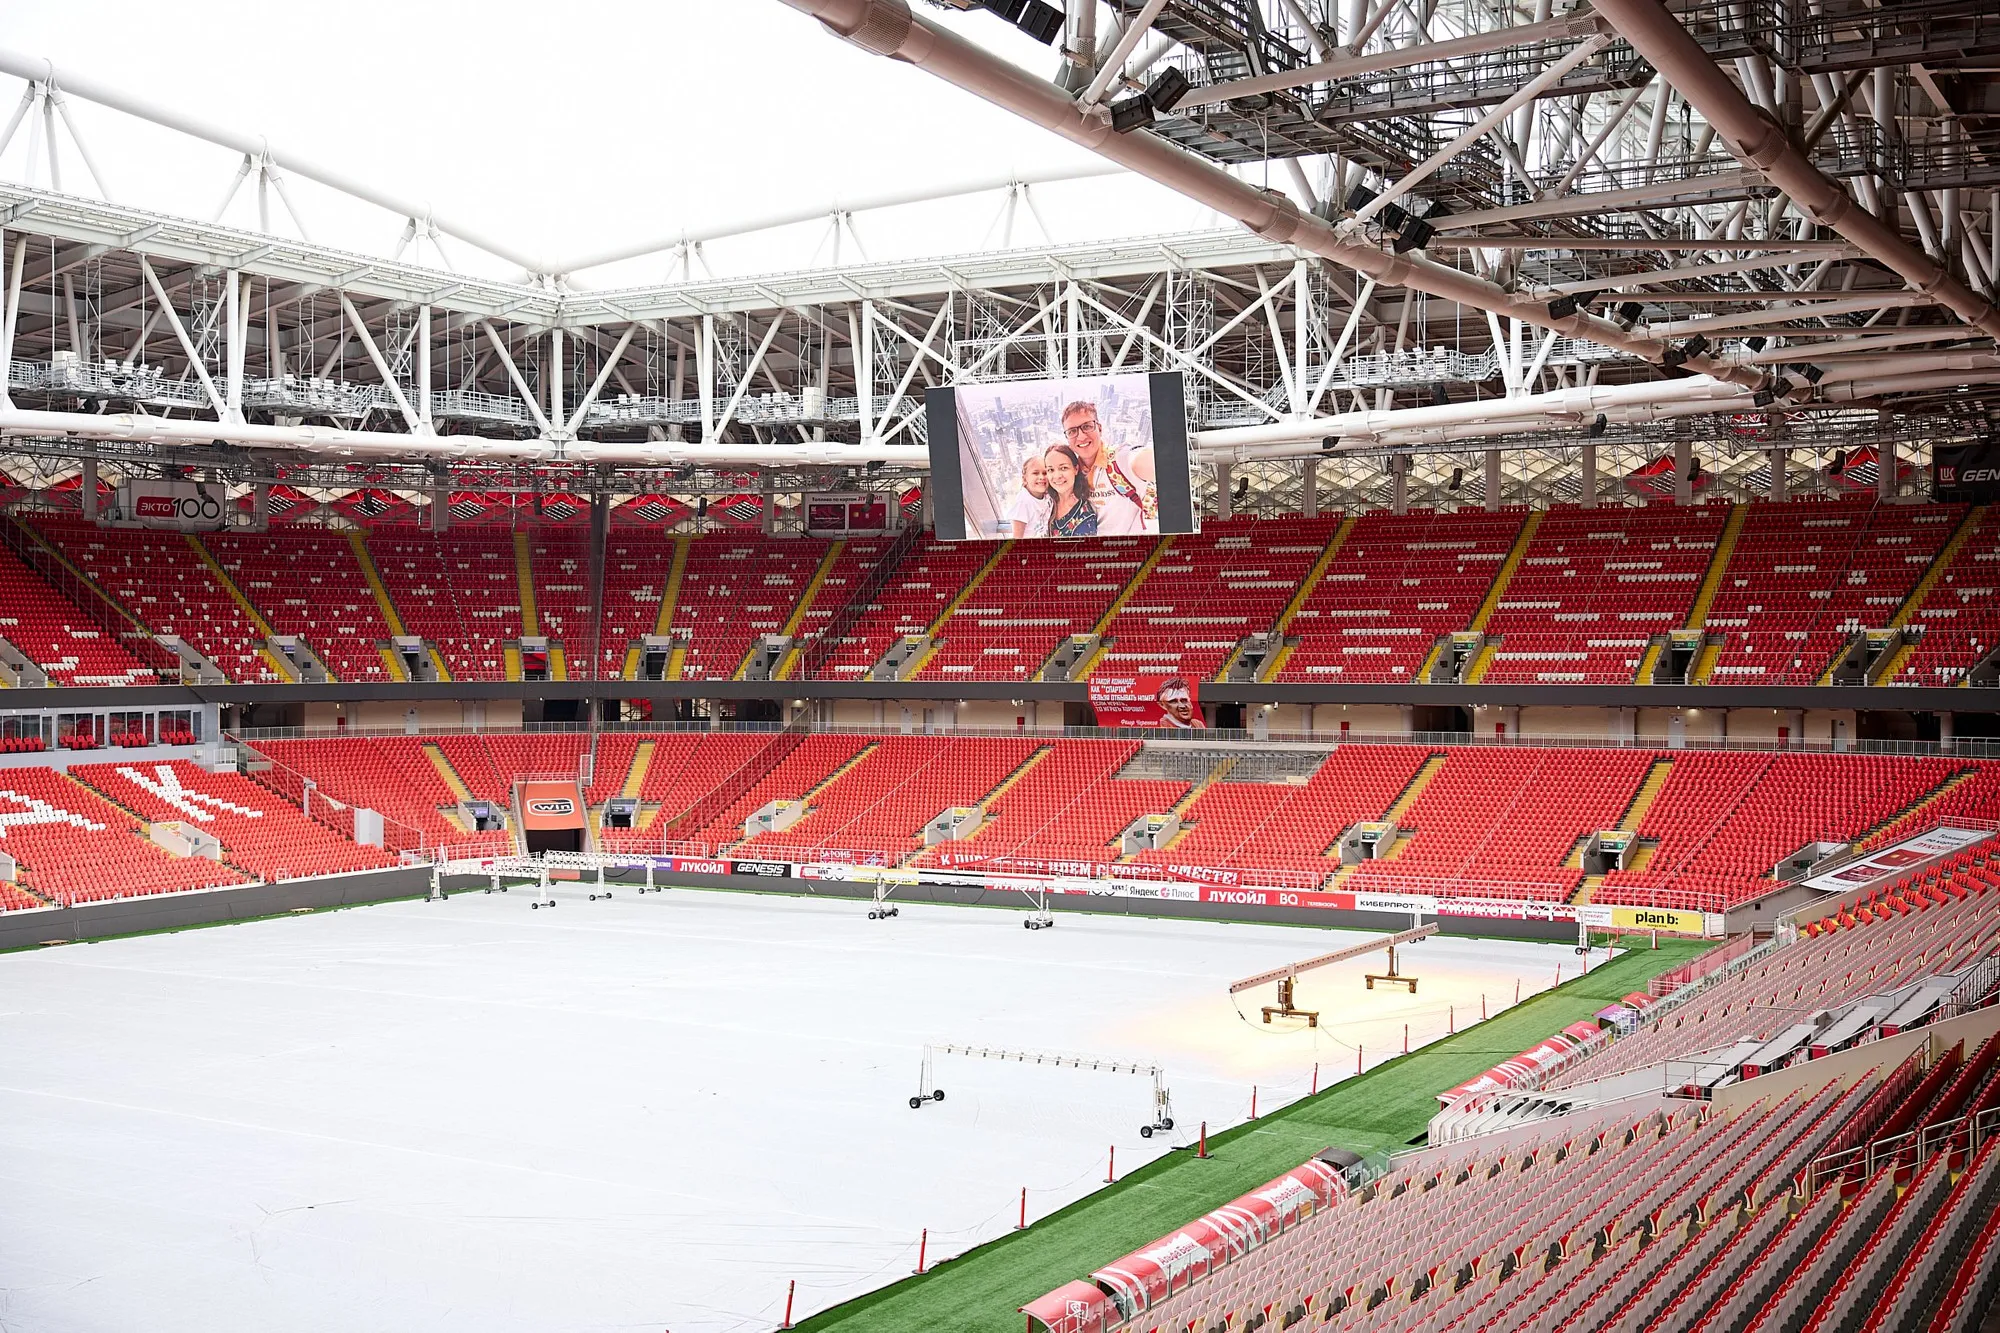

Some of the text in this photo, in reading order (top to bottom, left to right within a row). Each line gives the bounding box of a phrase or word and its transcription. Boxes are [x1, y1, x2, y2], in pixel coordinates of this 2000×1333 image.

[140, 497, 220, 519] ЭКТО 100
[680, 862, 724, 874] ЛУКОЙЛ
[737, 862, 785, 874] GENESIS
[1129, 886, 1159, 897] Яндекс
[1171, 888, 1195, 898] Плюс
[1208, 890, 1267, 905] ЛУКОЙЛ
[1279, 892, 1299, 905] BQ
[1635, 911, 1665, 925] plan
